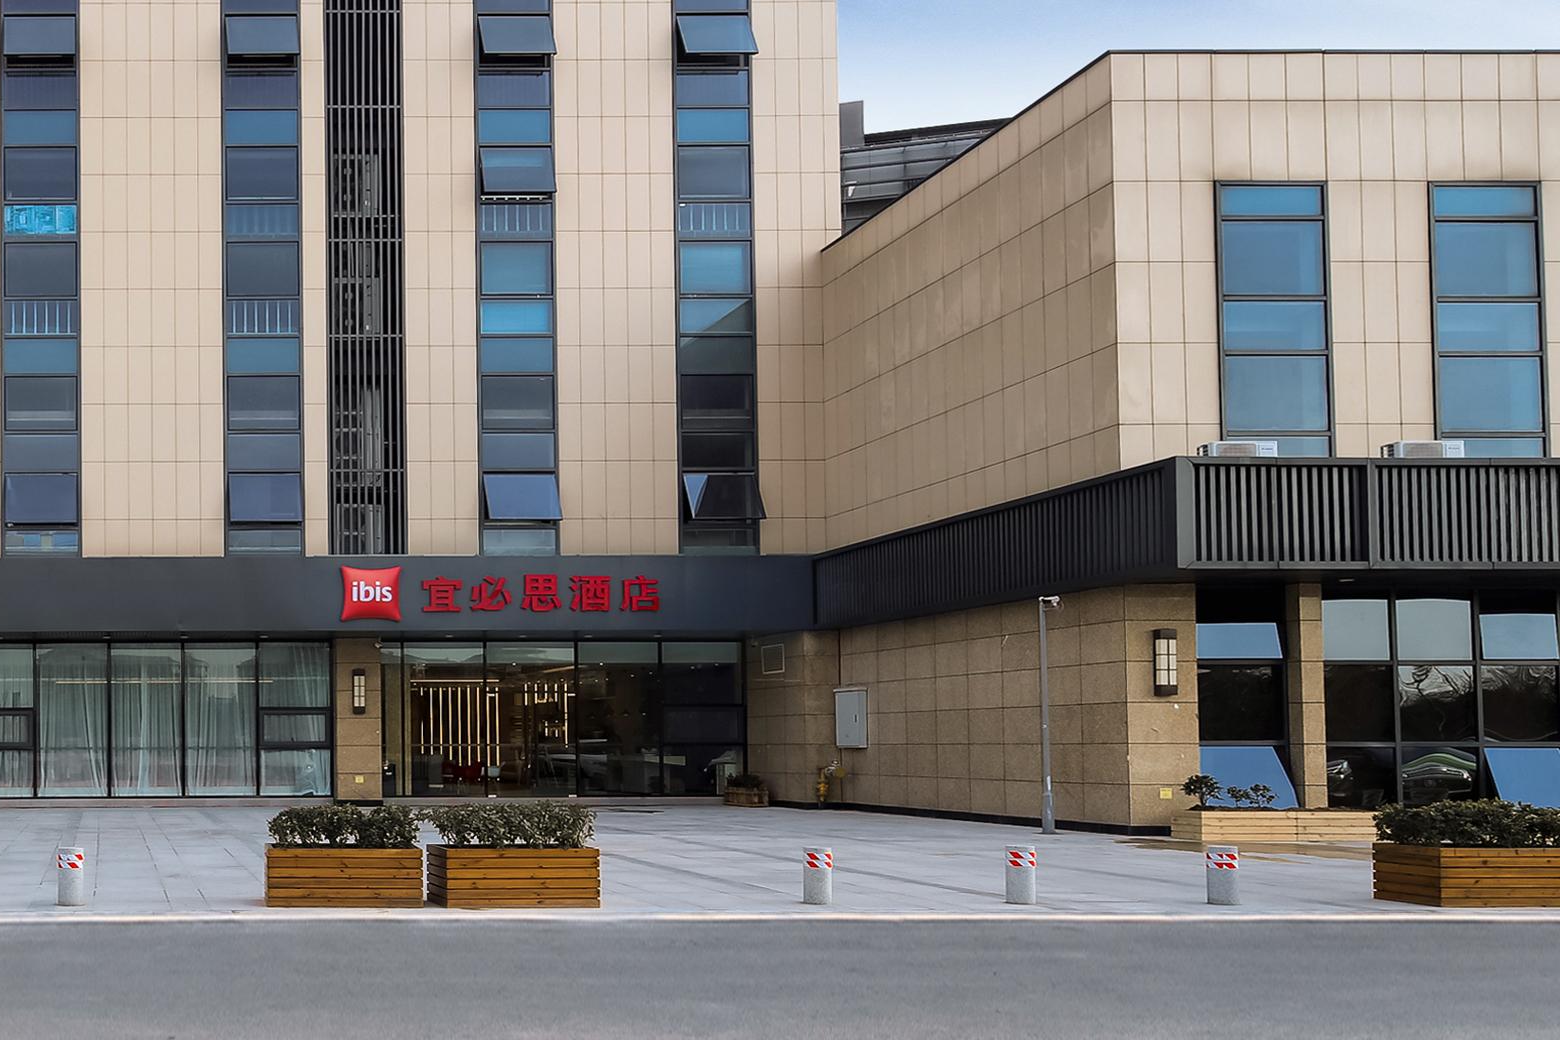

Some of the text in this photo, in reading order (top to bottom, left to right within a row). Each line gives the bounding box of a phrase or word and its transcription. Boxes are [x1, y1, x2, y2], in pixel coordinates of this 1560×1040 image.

[352, 581, 393, 602] ibis
[421, 574, 660, 613] 宜必思酒店
